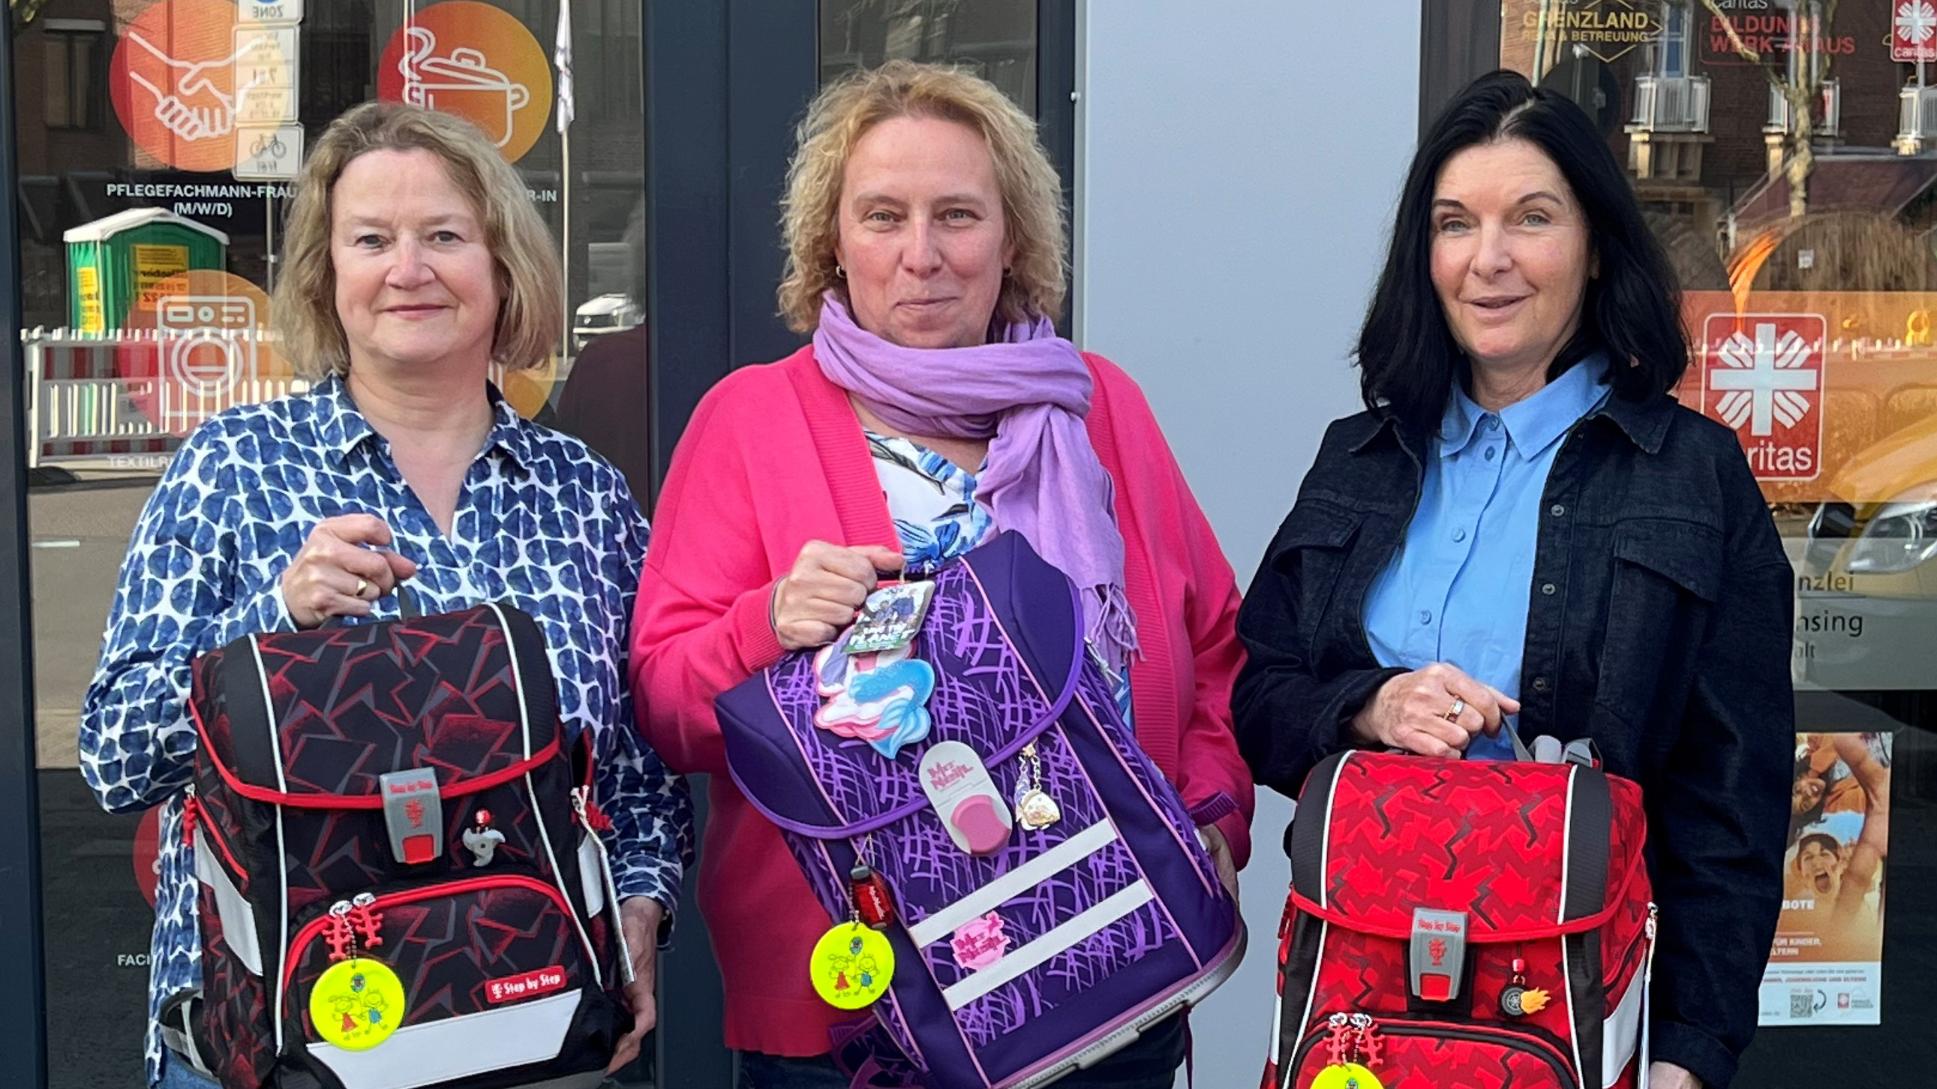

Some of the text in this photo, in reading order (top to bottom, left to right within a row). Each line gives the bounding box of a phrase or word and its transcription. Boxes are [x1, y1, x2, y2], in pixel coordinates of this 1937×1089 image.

[1711, 15, 1820, 33] BLDUNS
[1571, 30, 1649, 42] BETREUUNG
[106, 183, 298, 199] PFLEGEFACHMANN-FRAU
[527, 189, 557, 202] R-IN
[173, 202, 233, 217] (M/W/D)
[107, 455, 172, 468] TEXTILR
[1747, 440, 1813, 472] ritas
[1798, 571, 1855, 592] nzlei
[1797, 609, 1863, 638] nsing
[1794, 641, 1816, 659] alt
[1782, 898, 1815, 910] BOTE
[503, 974, 561, 995] Step by Step
